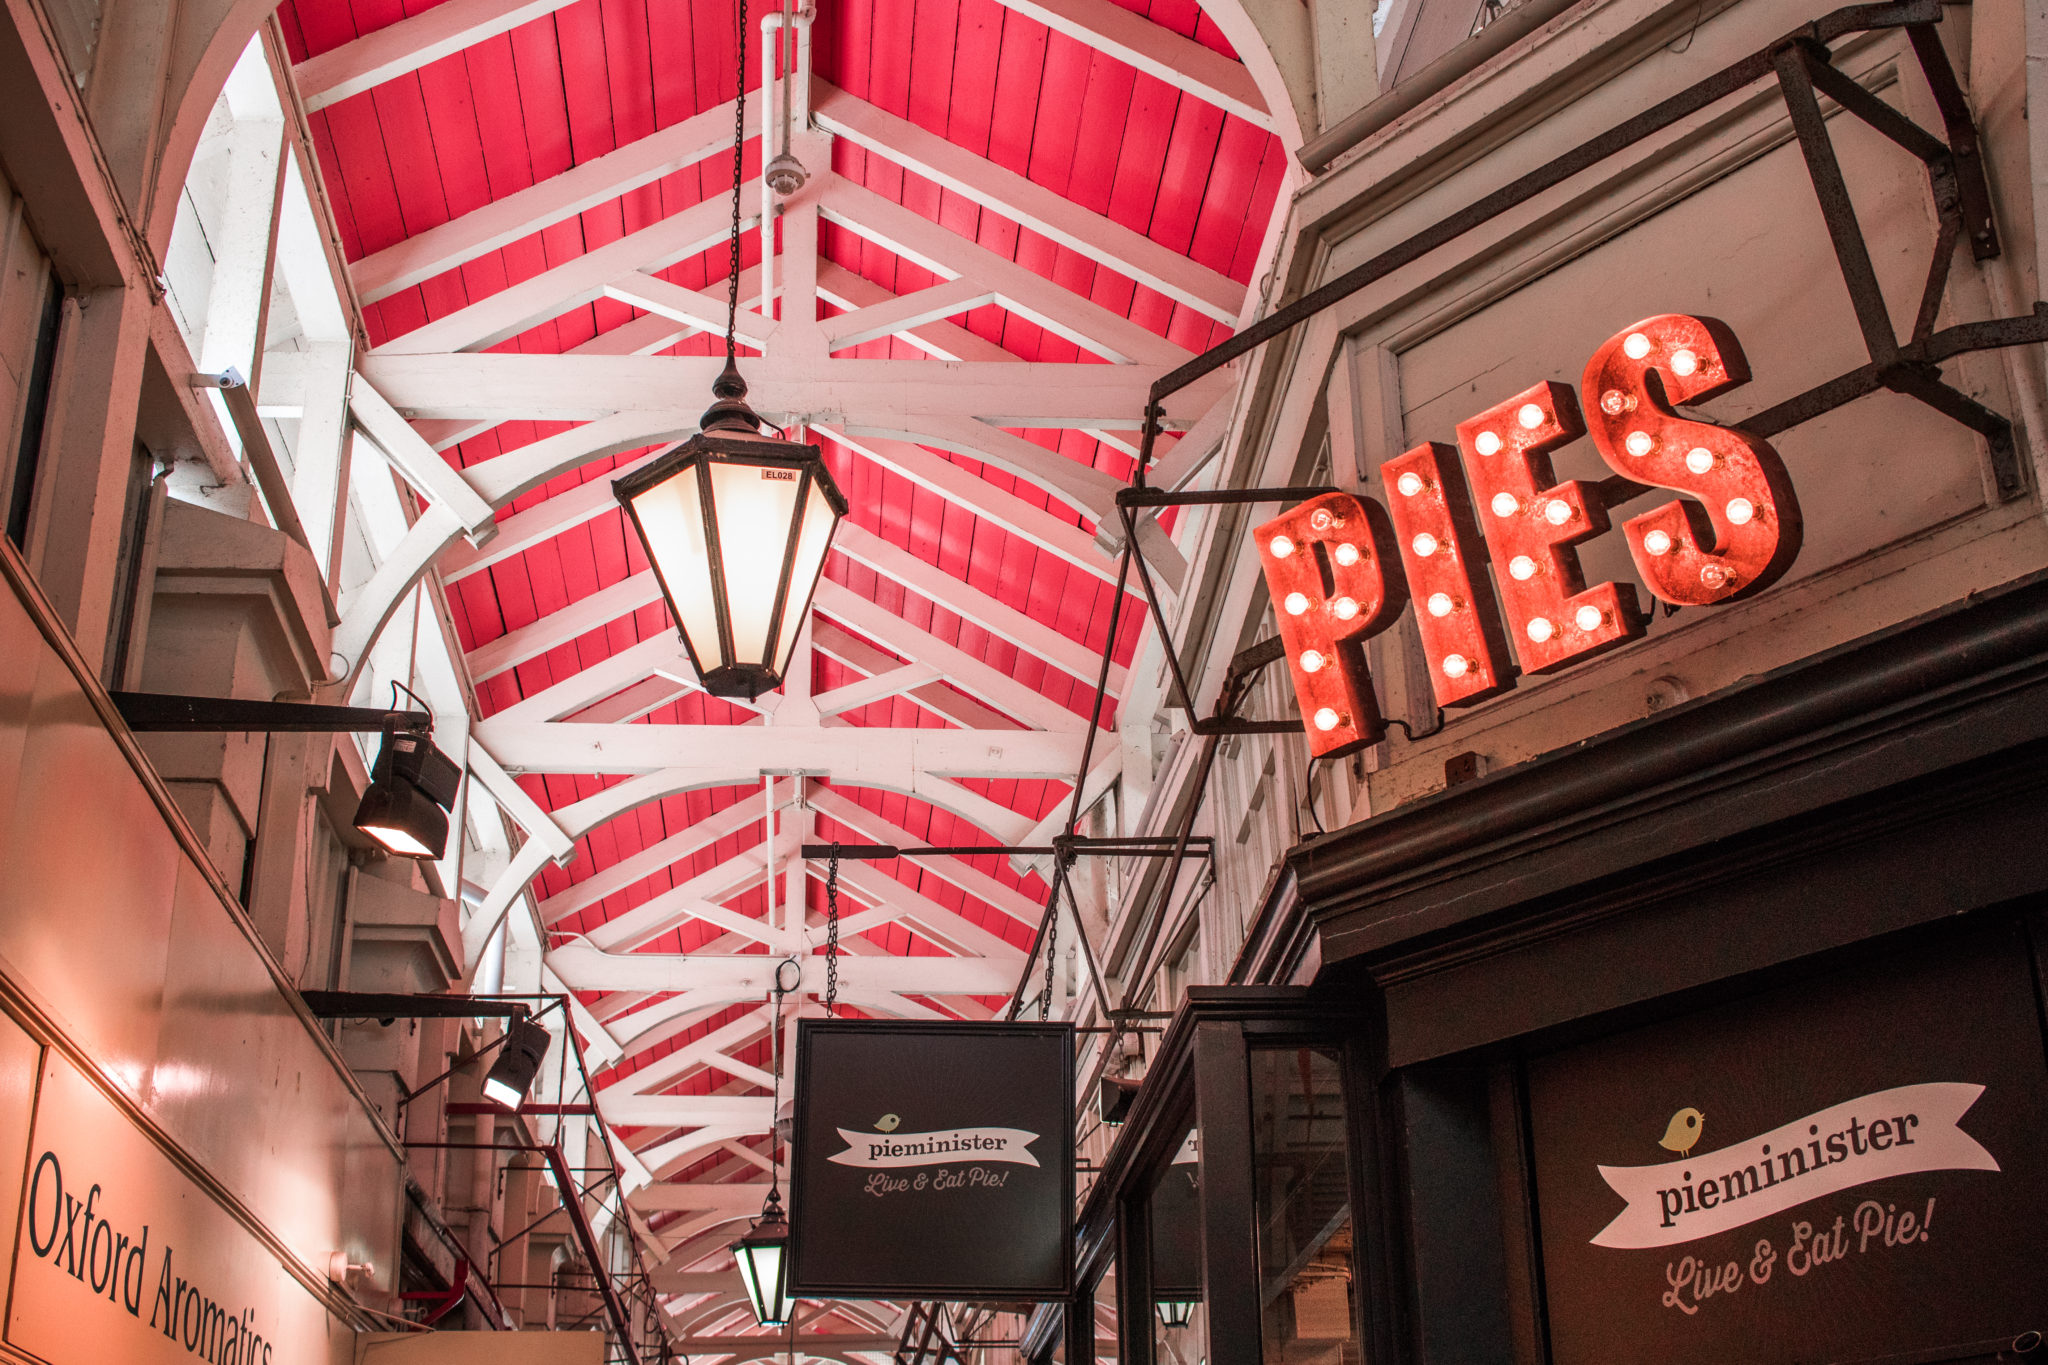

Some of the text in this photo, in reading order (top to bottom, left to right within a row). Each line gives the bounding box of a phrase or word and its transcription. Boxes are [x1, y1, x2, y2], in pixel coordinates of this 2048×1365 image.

[766, 470, 793, 480] EL028
[1253, 313, 1803, 758] PIES
[864, 1167, 1010, 1197] Live & Eat Pie!
[868, 1133, 1007, 1160] pieminister
[1656, 1112, 1919, 1227] pieminister
[29, 1151, 149, 1318] Oxford
[1662, 1198, 1936, 1315] Live & Eat Pie!
